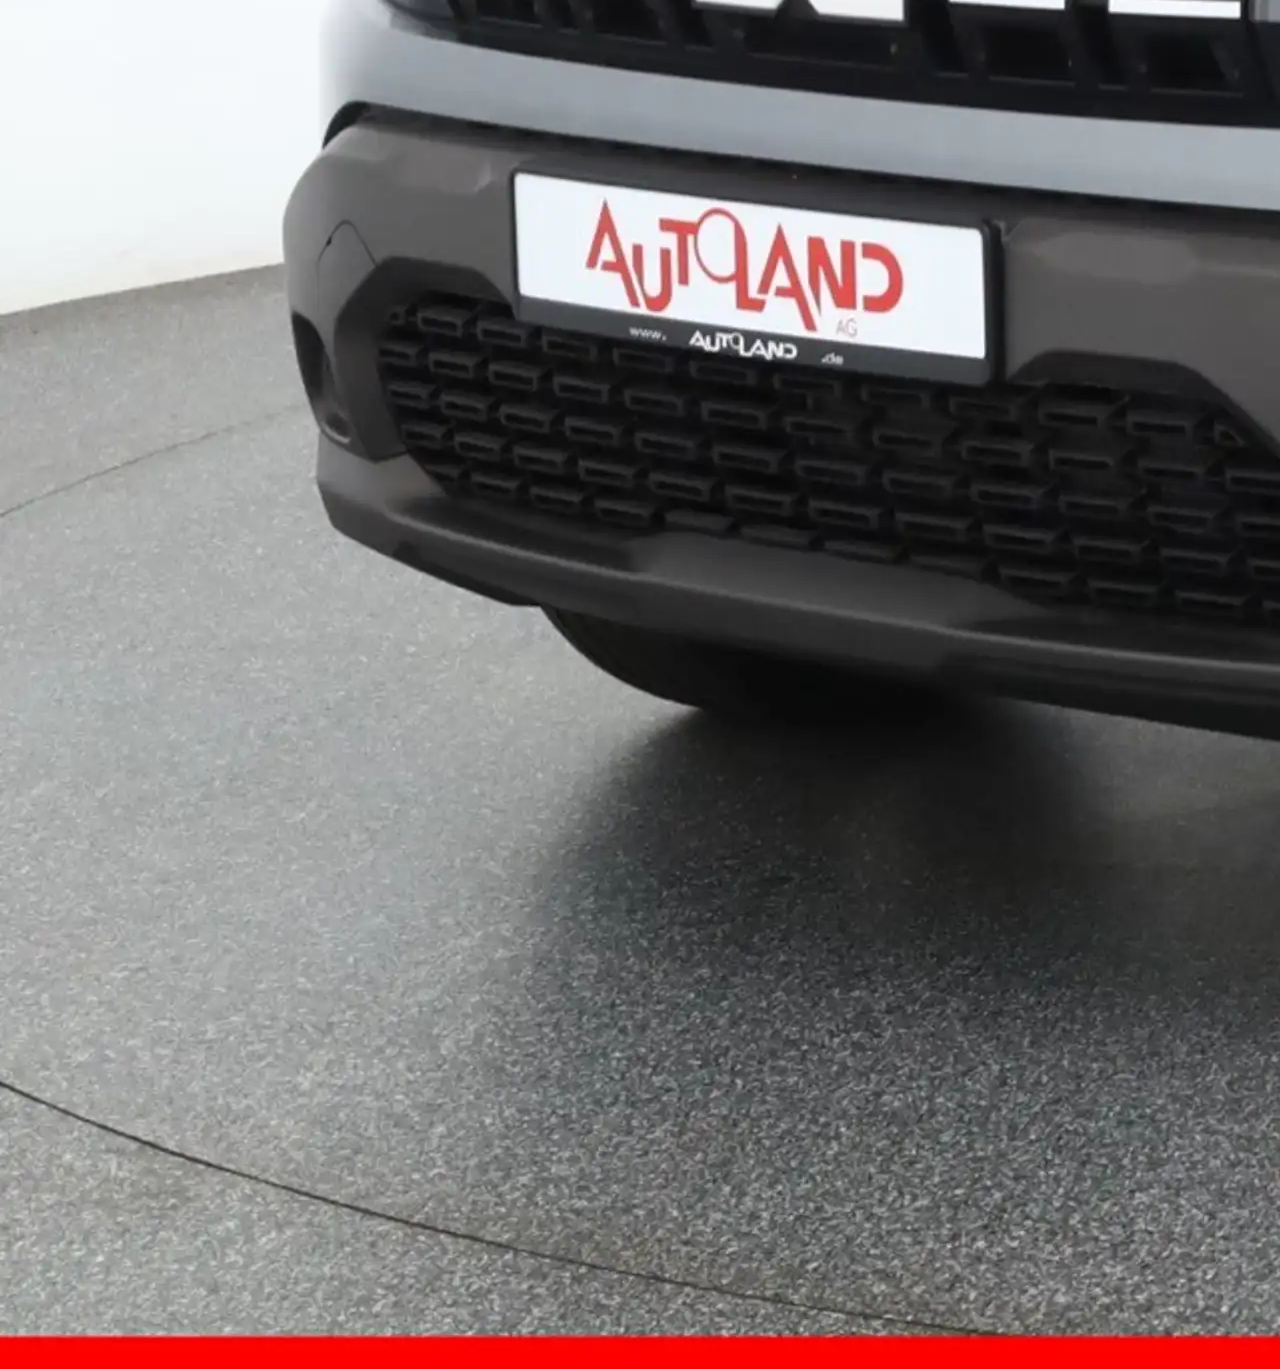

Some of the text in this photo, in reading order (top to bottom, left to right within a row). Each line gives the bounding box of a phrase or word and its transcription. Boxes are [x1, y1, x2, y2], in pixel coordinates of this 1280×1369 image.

[586, 198, 904, 332] AUTOLAND
[835, 317, 858, 337] AG
[688, 329, 799, 361] AUTOLAND
